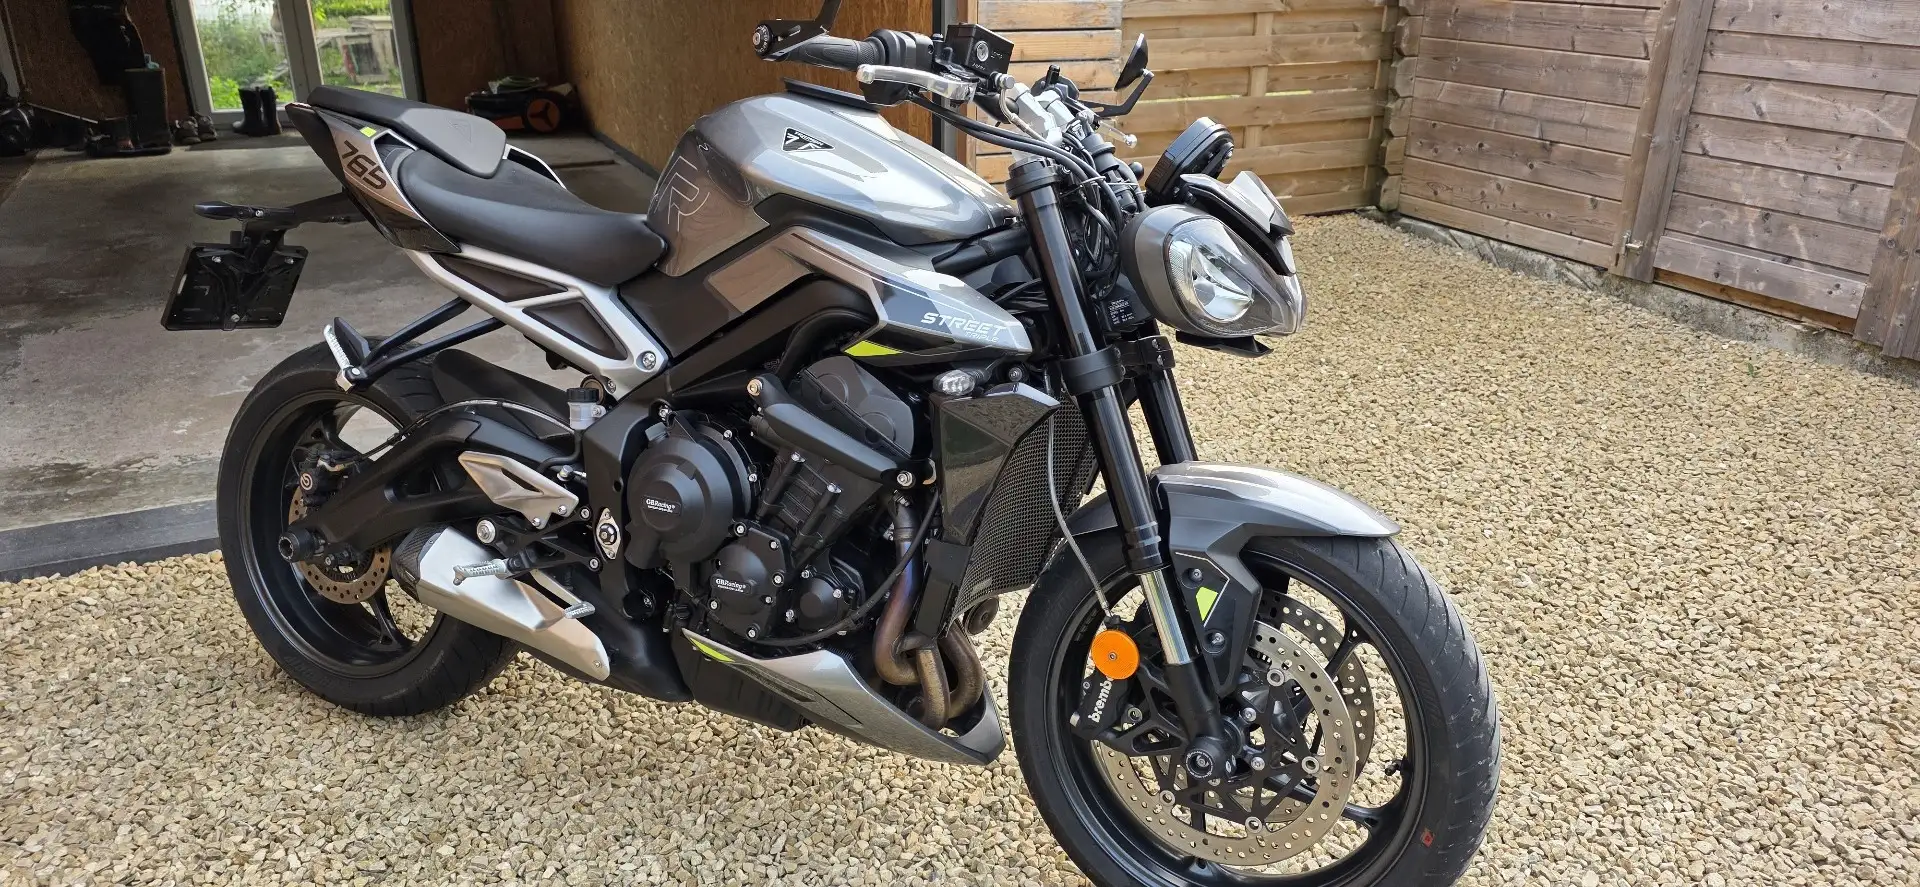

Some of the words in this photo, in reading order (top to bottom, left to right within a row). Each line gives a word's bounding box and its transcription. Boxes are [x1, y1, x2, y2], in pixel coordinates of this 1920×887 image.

[341, 139, 387, 190] 765
[920, 311, 1008, 337] STREET
[964, 331, 1000, 344] TRIPLE
